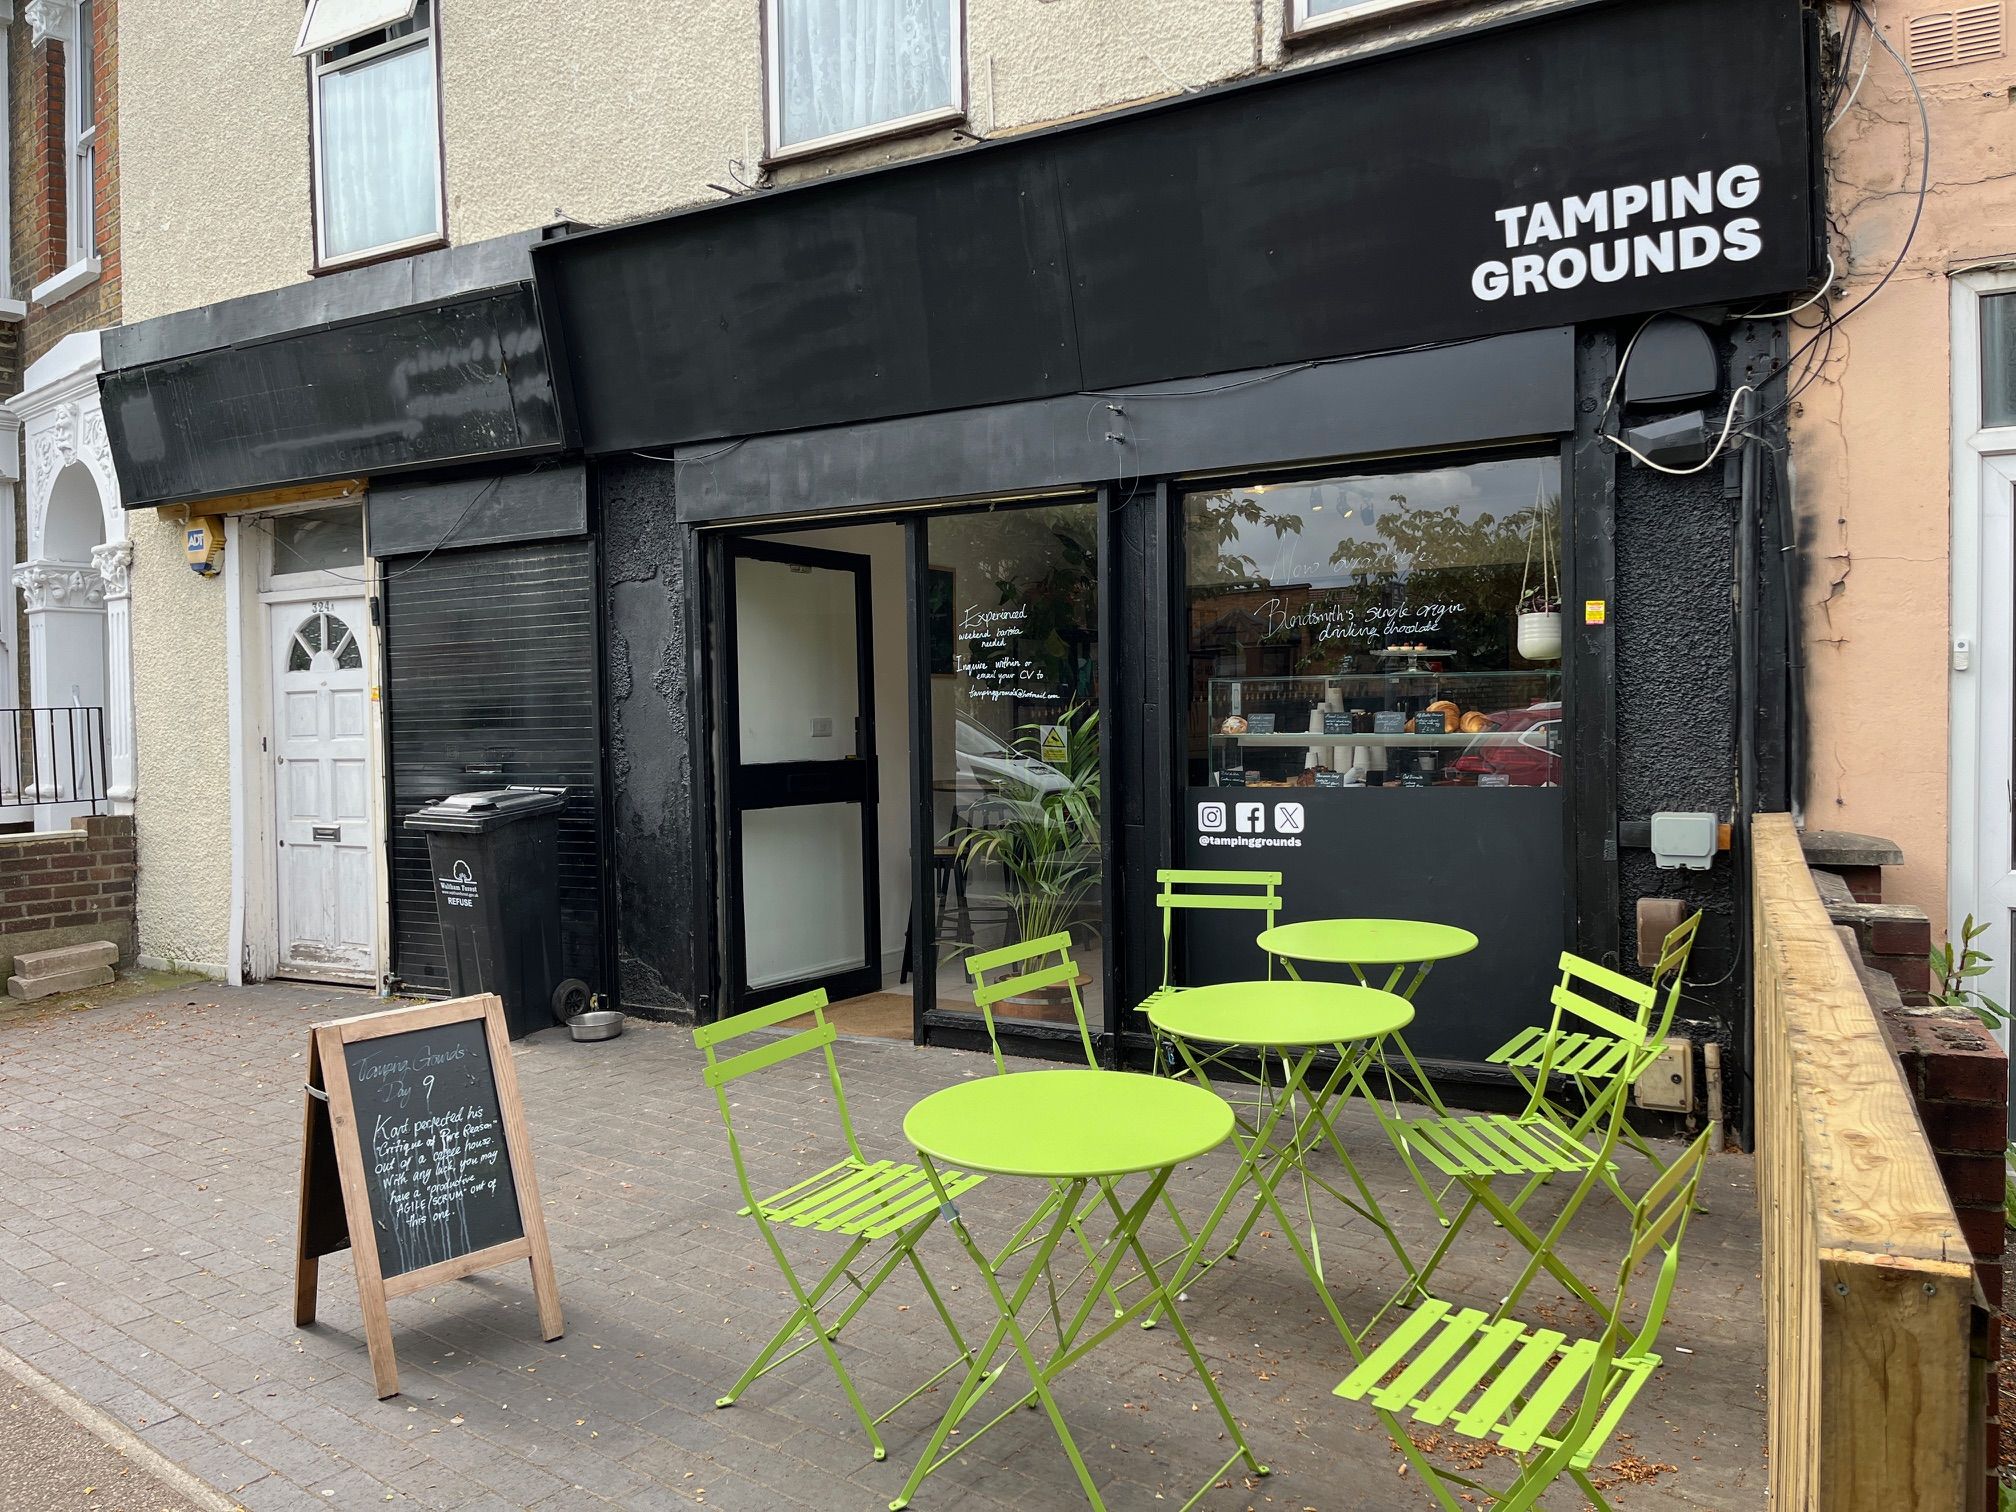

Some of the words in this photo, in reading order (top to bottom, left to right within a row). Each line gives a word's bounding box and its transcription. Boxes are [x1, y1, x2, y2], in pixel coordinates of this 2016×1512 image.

[1494, 164, 1761, 248] TAMPING
[1471, 217, 1762, 301] GROUNDS
[188, 534, 204, 547] ADT
[1270, 532, 1320, 584] Now
[1365, 602, 1410, 627] single
[1416, 600, 1465, 623] origin
[958, 630, 991, 641] weekend
[996, 626, 1023, 638] barista
[1319, 621, 1380, 644] drinking
[1383, 621, 1440, 635] chocolate
[981, 638, 1007, 648] needed
[956, 655, 988, 676] Inquire
[995, 656, 1021, 669] within
[976, 670, 996, 679] email
[998, 672, 1015, 684] your
[1019, 670, 1035, 679] CV
[1036, 670, 1044, 679] to
[1199, 835, 1302, 848] @tampinggrounds
[440, 882, 461, 890] Waltham
[447, 897, 472, 907] REFUSE
[378, 1080, 412, 1109] Day
[422, 1074, 435, 1099] 9
[414, 1106, 464, 1136] perfected
[467, 1106, 484, 1120] his
[426, 1135, 436, 1147] of
[440, 1128, 460, 1144] Pure
[375, 1157, 396, 1174] out
[400, 1156, 412, 1171] of
[418, 1155, 427, 1164] a
[433, 1146, 462, 1162] coffee
[465, 1137, 495, 1152] house.
[383, 1171, 408, 1189] With
[413, 1168, 432, 1184] any
[459, 1156, 479, 1172] you
[480, 1149, 498, 1165] may
[470, 1181, 487, 1194] out
[487, 1178, 497, 1192] of
[389, 1189, 411, 1205] have
[413, 1189, 422, 1198] a
[406, 1213, 427, 1228] this
